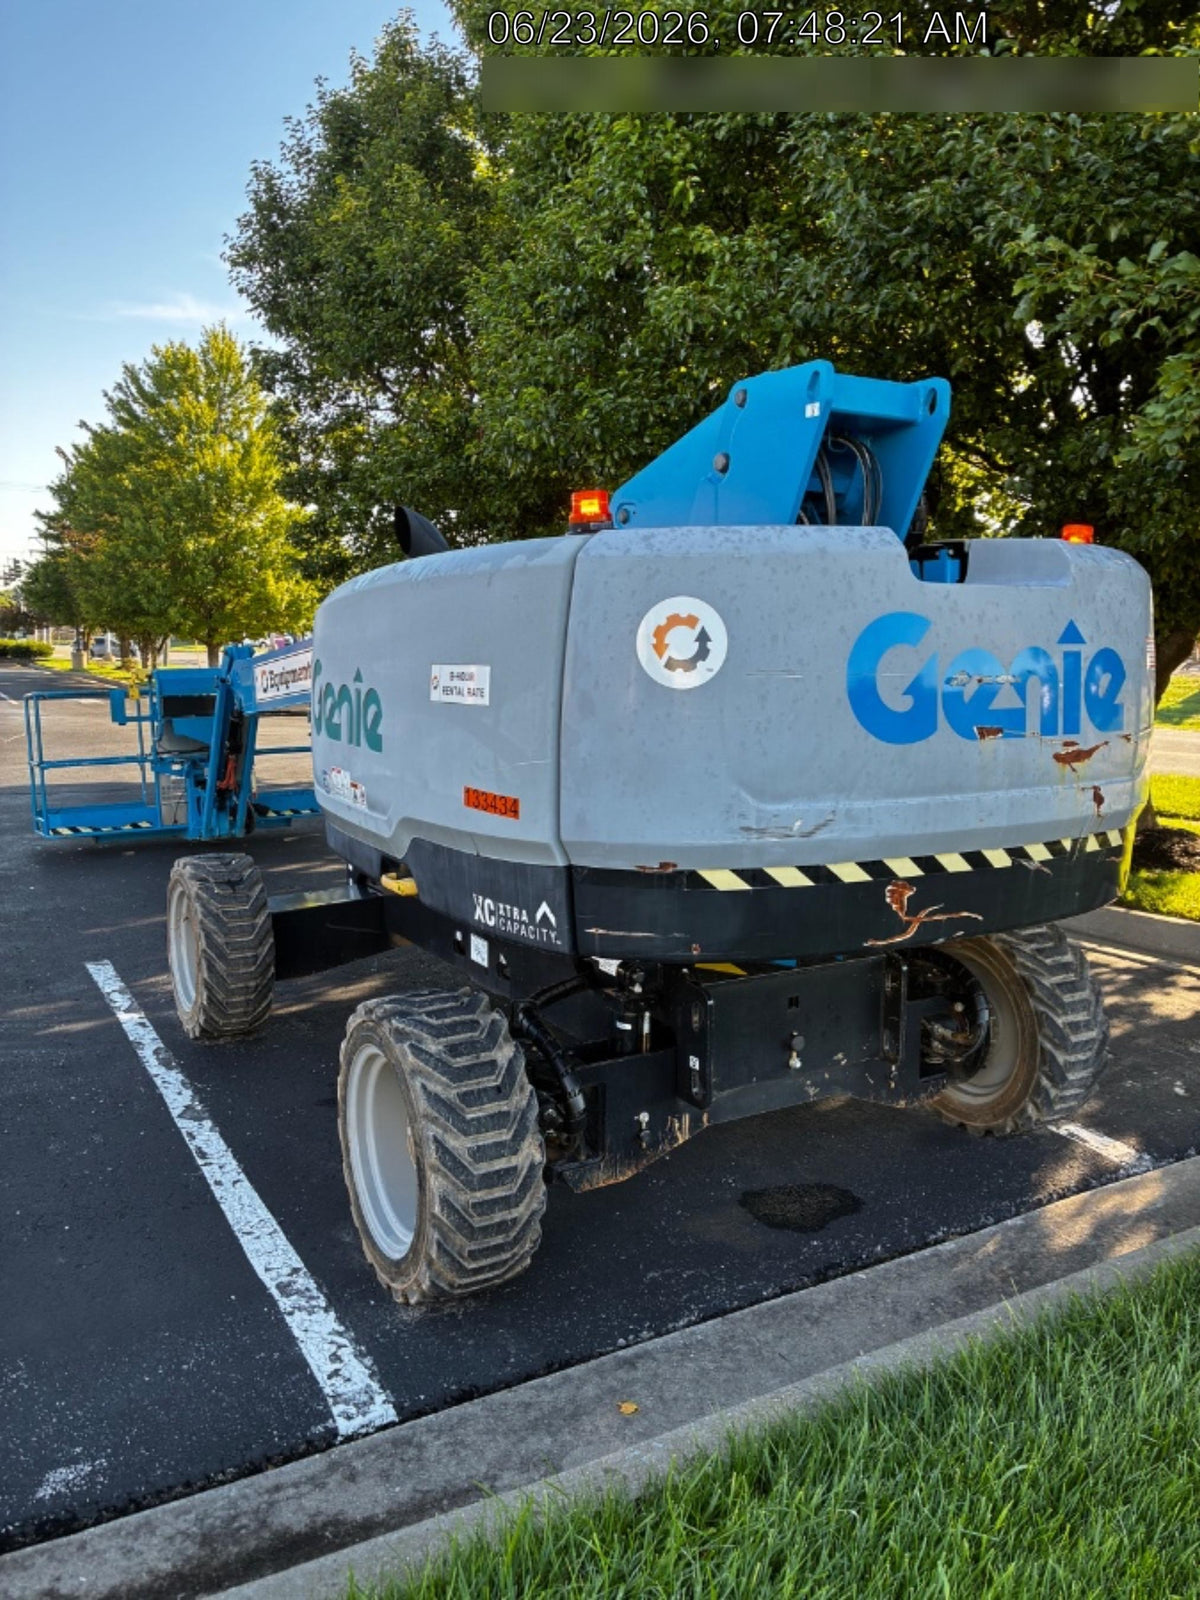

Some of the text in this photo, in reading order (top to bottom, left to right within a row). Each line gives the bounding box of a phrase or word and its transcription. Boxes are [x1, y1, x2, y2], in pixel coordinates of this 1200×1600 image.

[442, 685, 485, 699] RENTAL RATE
[847, 611, 1127, 745] Genie
[312, 659, 383, 753] Genie
[464, 786, 519, 820] 133434
[472, 892, 529, 927] XC XTRA
[499, 917, 559, 944] CAPACITY
